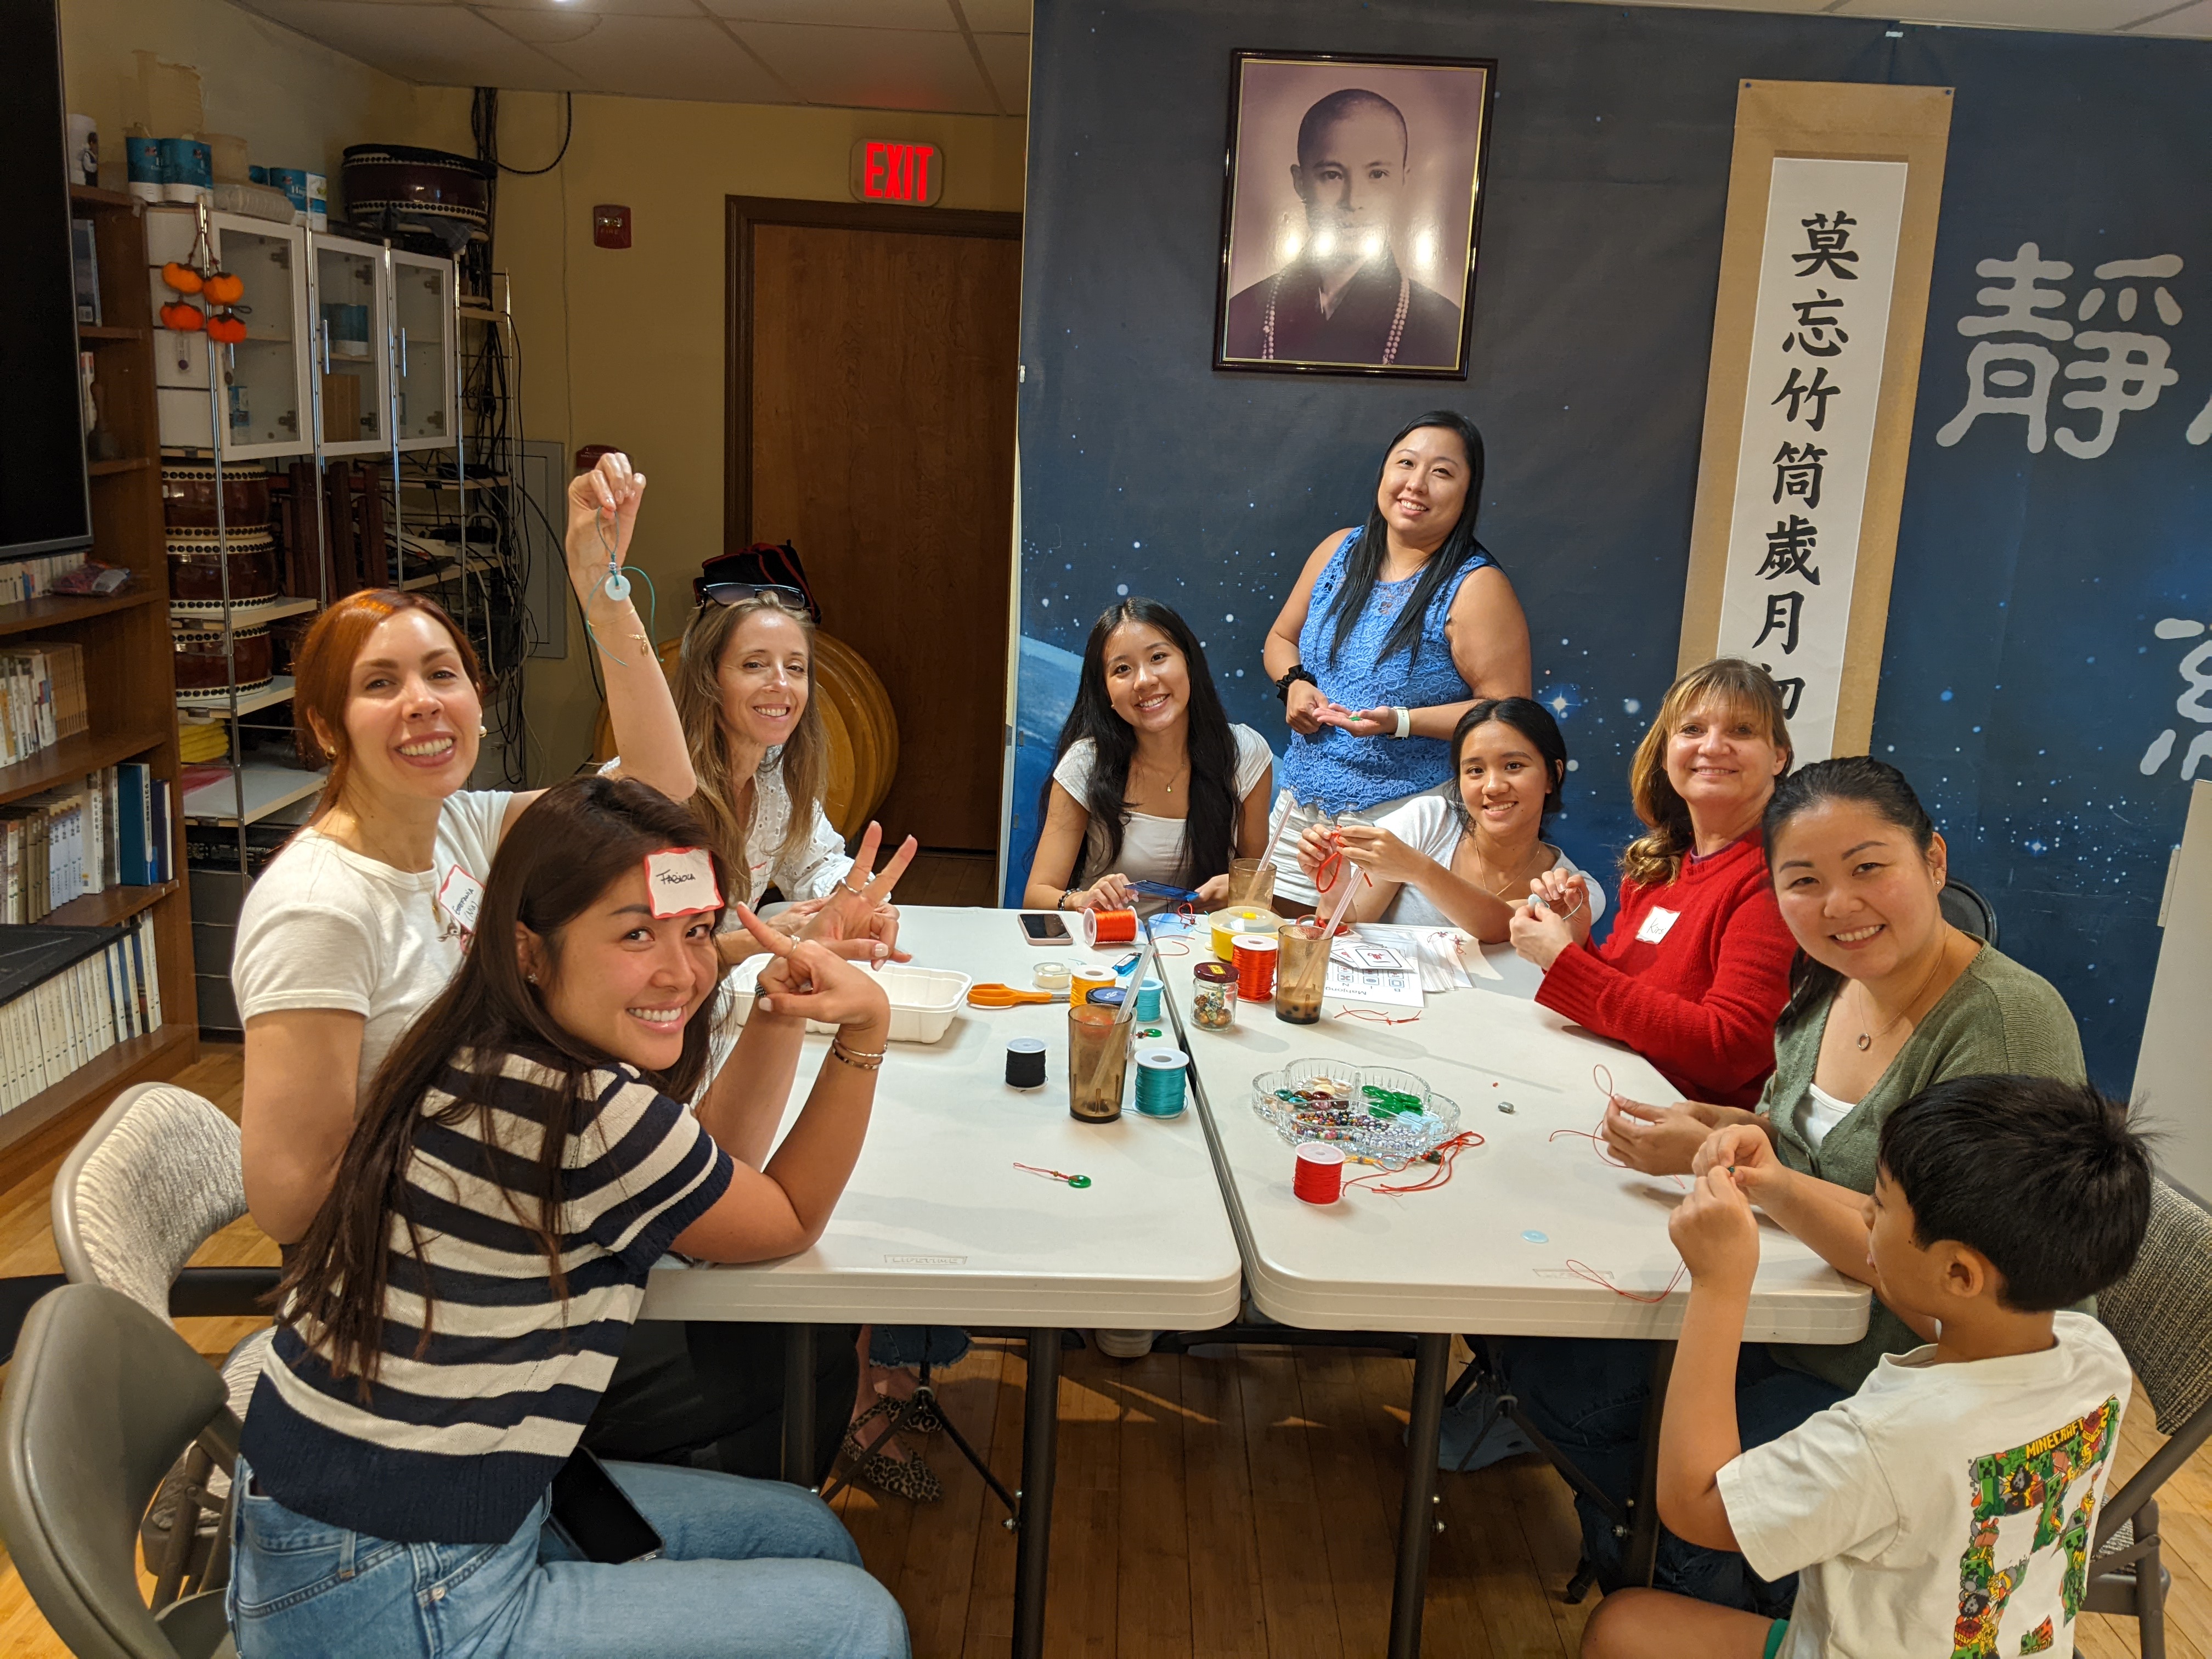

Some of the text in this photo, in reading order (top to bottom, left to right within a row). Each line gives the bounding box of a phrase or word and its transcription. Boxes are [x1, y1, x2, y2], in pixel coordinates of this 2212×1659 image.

[865, 143, 933, 201] EXIT
[1936, 242, 2212, 459] 靜
[1325, 986, 1367, 995] Mahjong
[2025, 1418, 2084, 1459] MINECRAFT
